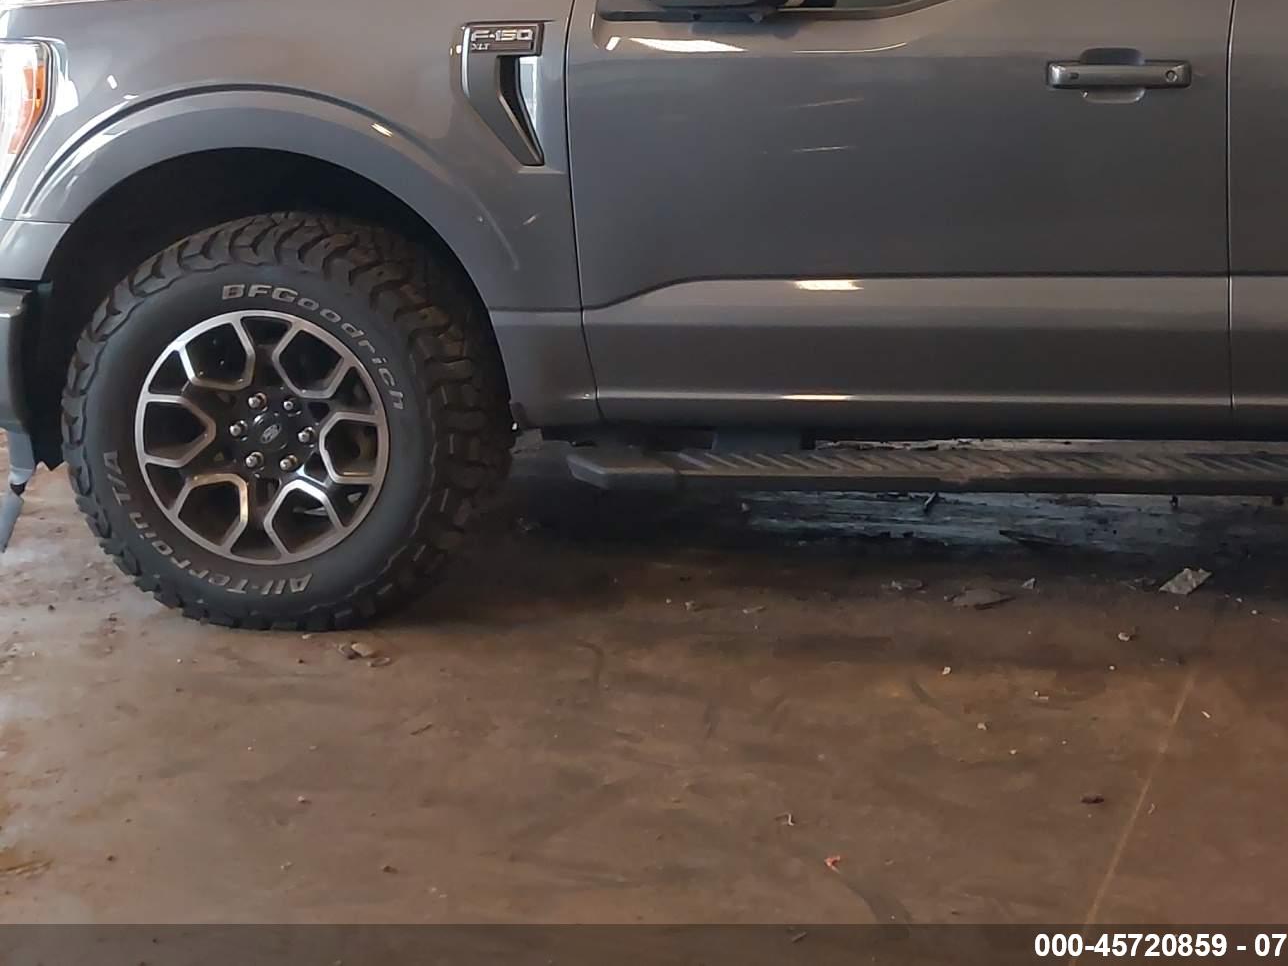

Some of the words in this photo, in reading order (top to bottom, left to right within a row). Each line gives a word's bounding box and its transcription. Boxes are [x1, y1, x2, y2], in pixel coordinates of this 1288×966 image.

[471, 29, 534, 42] F-150
[471, 43, 491, 51] XLT
[222, 284, 404, 410] BFGoodrich
[104, 450, 131, 507] T/A
[129, 512, 313, 595] All-Terrain
